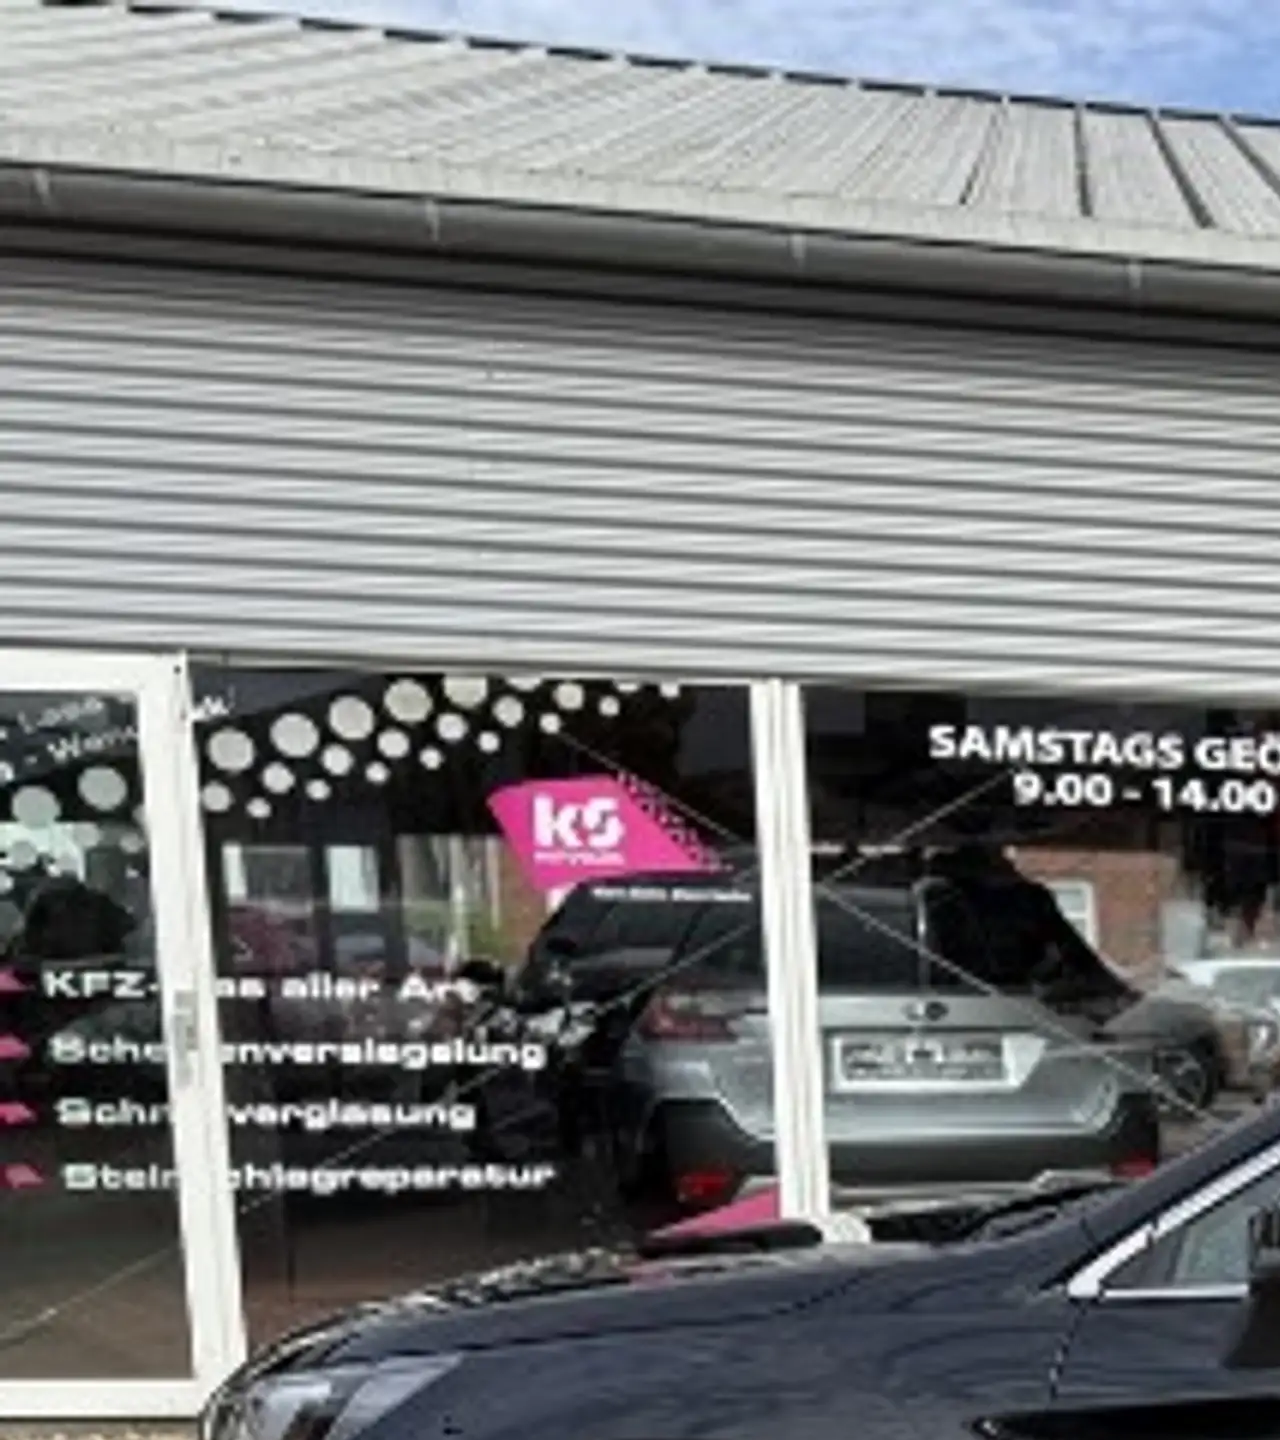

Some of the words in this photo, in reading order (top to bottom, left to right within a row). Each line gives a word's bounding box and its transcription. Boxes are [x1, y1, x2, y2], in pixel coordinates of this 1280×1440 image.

[928, 724, 1185, 769] SAMSTAGS
[1013, 770, 1113, 807] 9.00
[1151, 777, 1275, 814] 14.00
[43, 969, 266, 999] KFZ-as
[281, 970, 382, 999] aller
[50, 1032, 548, 1071] Scheenversiegelung
[62, 1161, 556, 1196] Steinchlagreparatur
